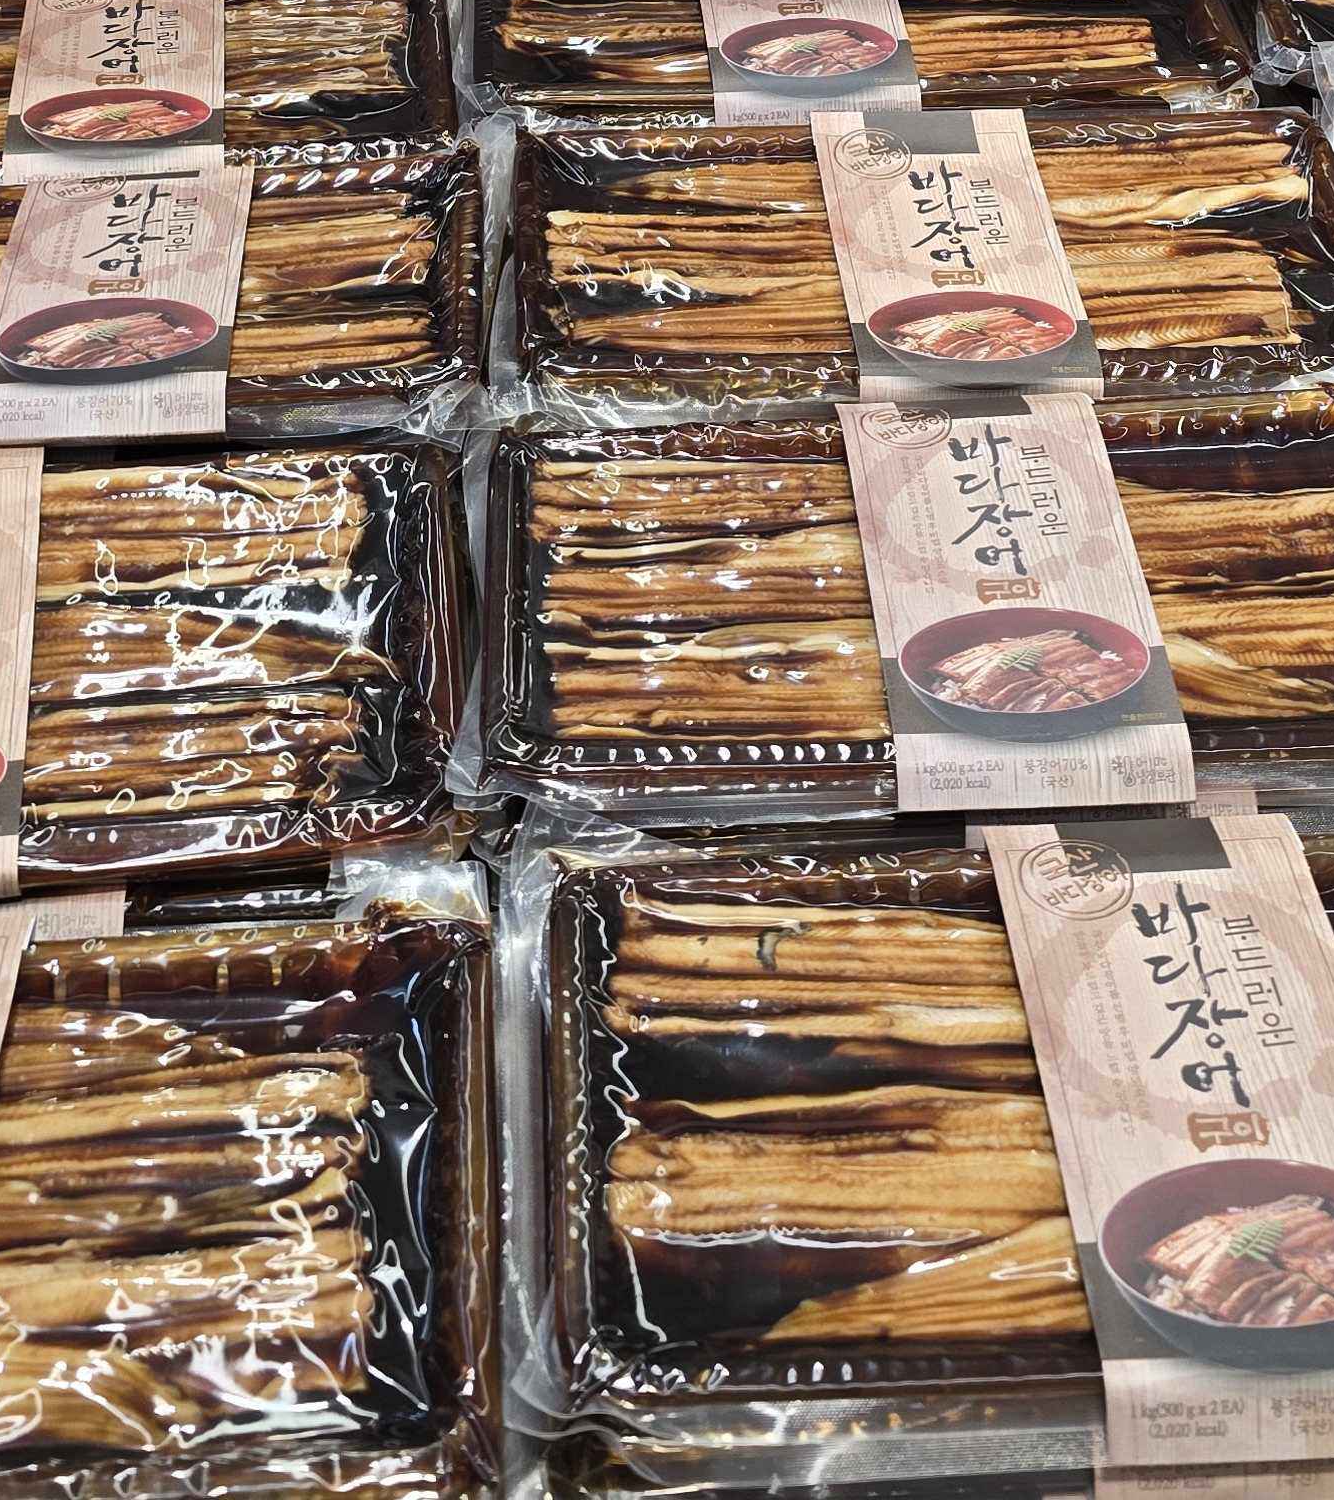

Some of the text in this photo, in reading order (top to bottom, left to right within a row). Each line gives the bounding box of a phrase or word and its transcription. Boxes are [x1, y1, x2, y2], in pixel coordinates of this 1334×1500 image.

[88, 0, 155, 73] 바다장어
[83, 183, 172, 277] 바다장어
[908, 160, 979, 268] 바다장어
[947, 423, 1033, 575] 바다장어
[1132, 880, 1248, 1108] 바다장어
